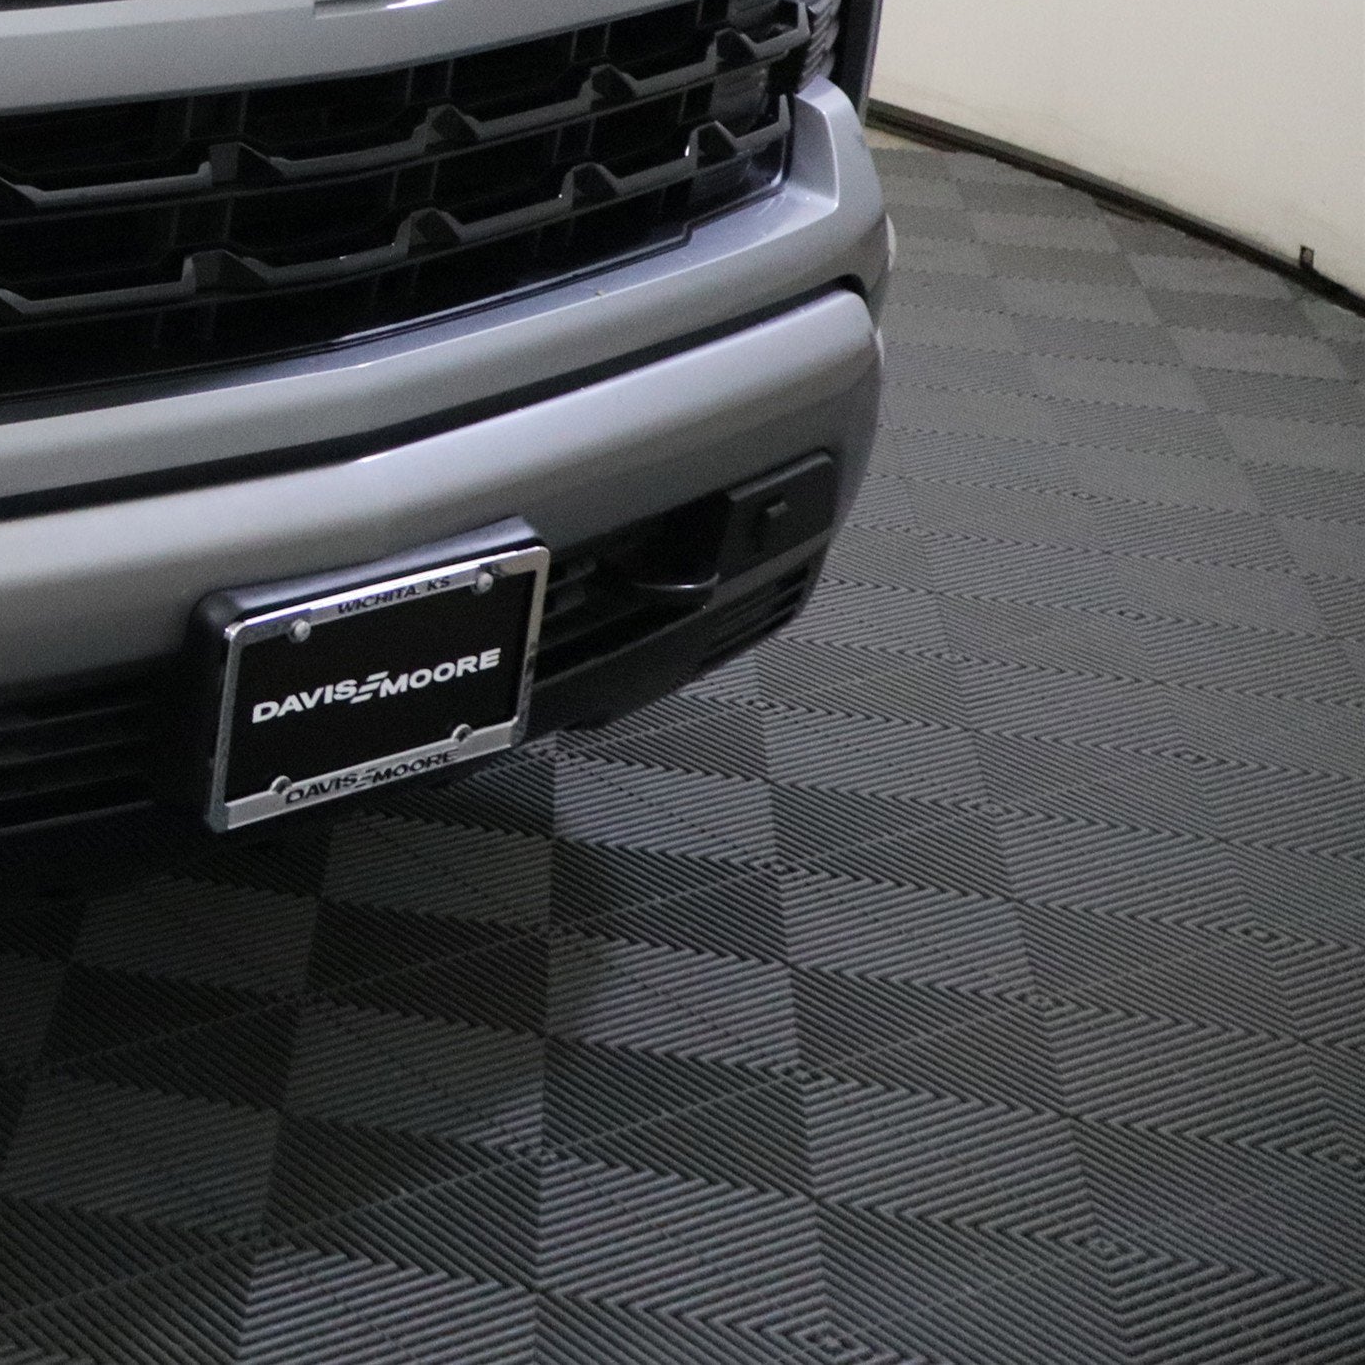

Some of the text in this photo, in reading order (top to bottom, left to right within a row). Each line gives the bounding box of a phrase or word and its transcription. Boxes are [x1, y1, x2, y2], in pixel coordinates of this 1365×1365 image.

[426, 575, 451, 592] KS
[251, 647, 502, 724] DAVIS MOORE
[285, 748, 460, 805] DAVIS MOORE
